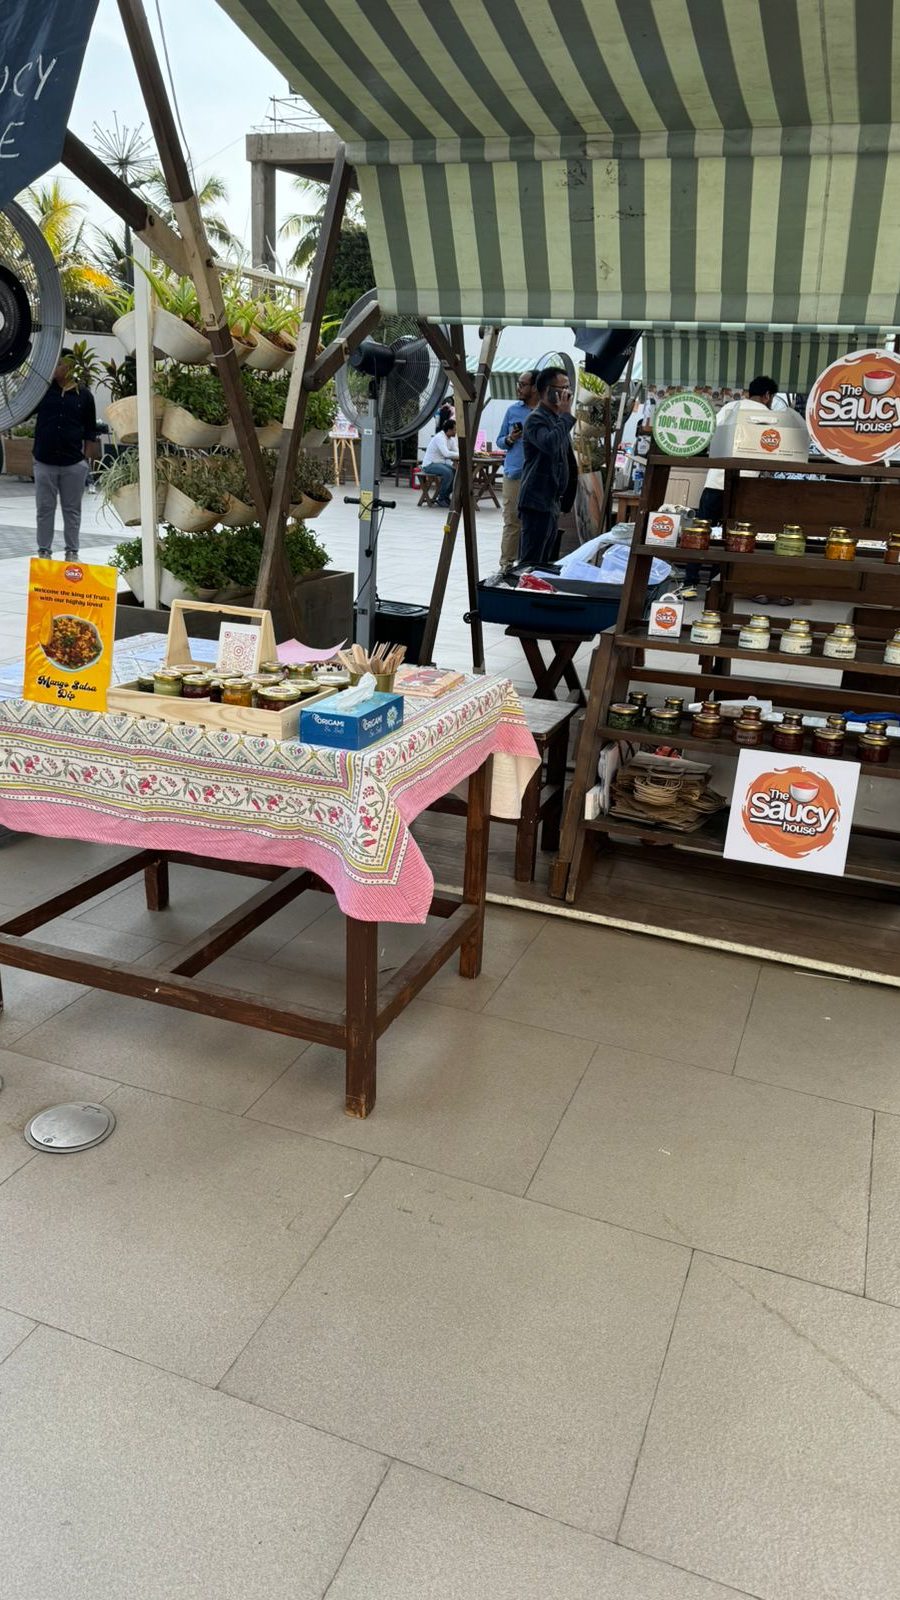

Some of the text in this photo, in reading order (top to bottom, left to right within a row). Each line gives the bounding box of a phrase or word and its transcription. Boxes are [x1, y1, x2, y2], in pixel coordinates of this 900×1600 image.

[840, 384, 863, 396] The
[658, 415, 711, 433] 100% NATURAL
[855, 420, 893, 432] house
[34, 587, 59, 595] Welcome
[71, 591, 85, 599] king
[37, 675, 97, 692] Mango Salsa
[57, 689, 76, 701] Dip
[313, 715, 345, 727] ORIGAMI
[770, 789, 790, 800] The
[749, 792, 835, 832] Saucy
[782, 822, 816, 835] house
